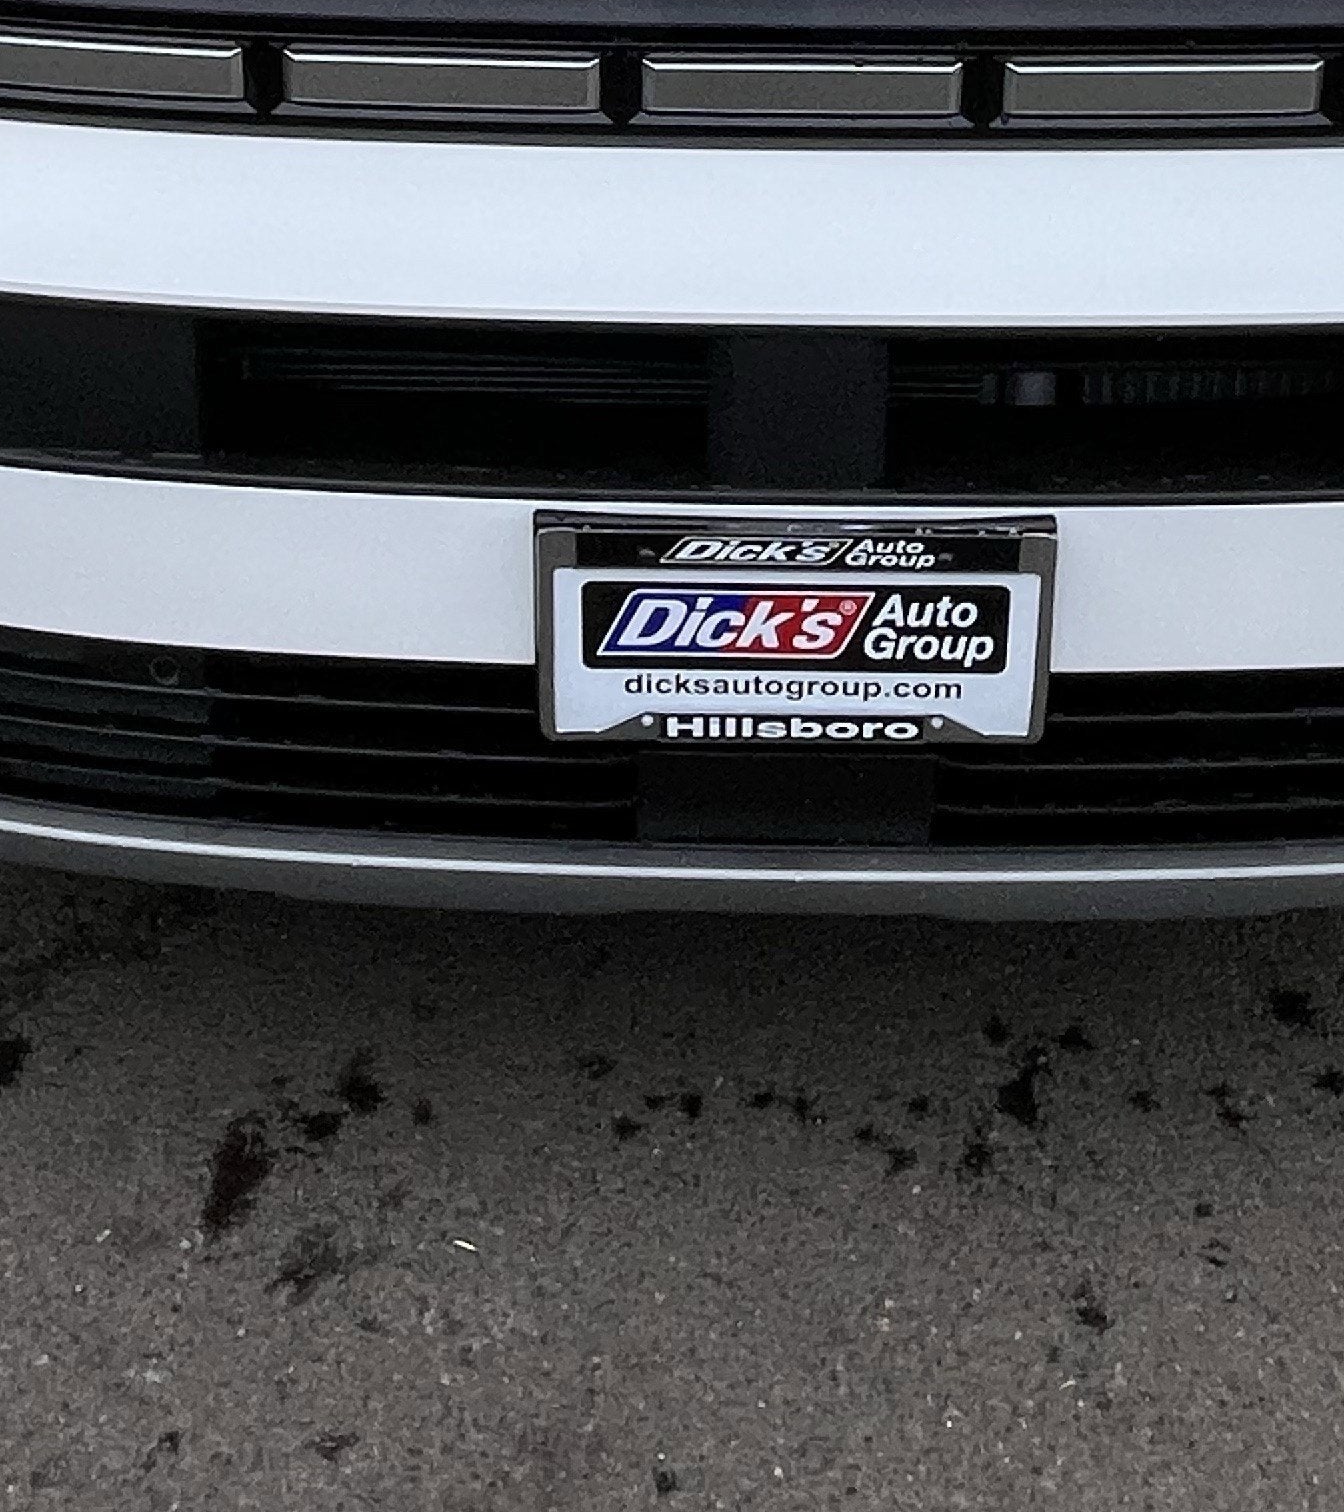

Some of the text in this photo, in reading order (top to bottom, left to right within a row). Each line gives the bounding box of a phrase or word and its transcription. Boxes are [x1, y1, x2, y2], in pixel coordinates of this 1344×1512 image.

[676, 539, 832, 562] Dick's
[855, 538, 925, 555] Auto
[843, 552, 936, 570] Group
[616, 596, 844, 650] Dick's
[872, 594, 978, 629] Auto
[863, 631, 995, 668] Group
[623, 673, 962, 703] dicksautogroup.com
[665, 716, 920, 740] Hillsboro
